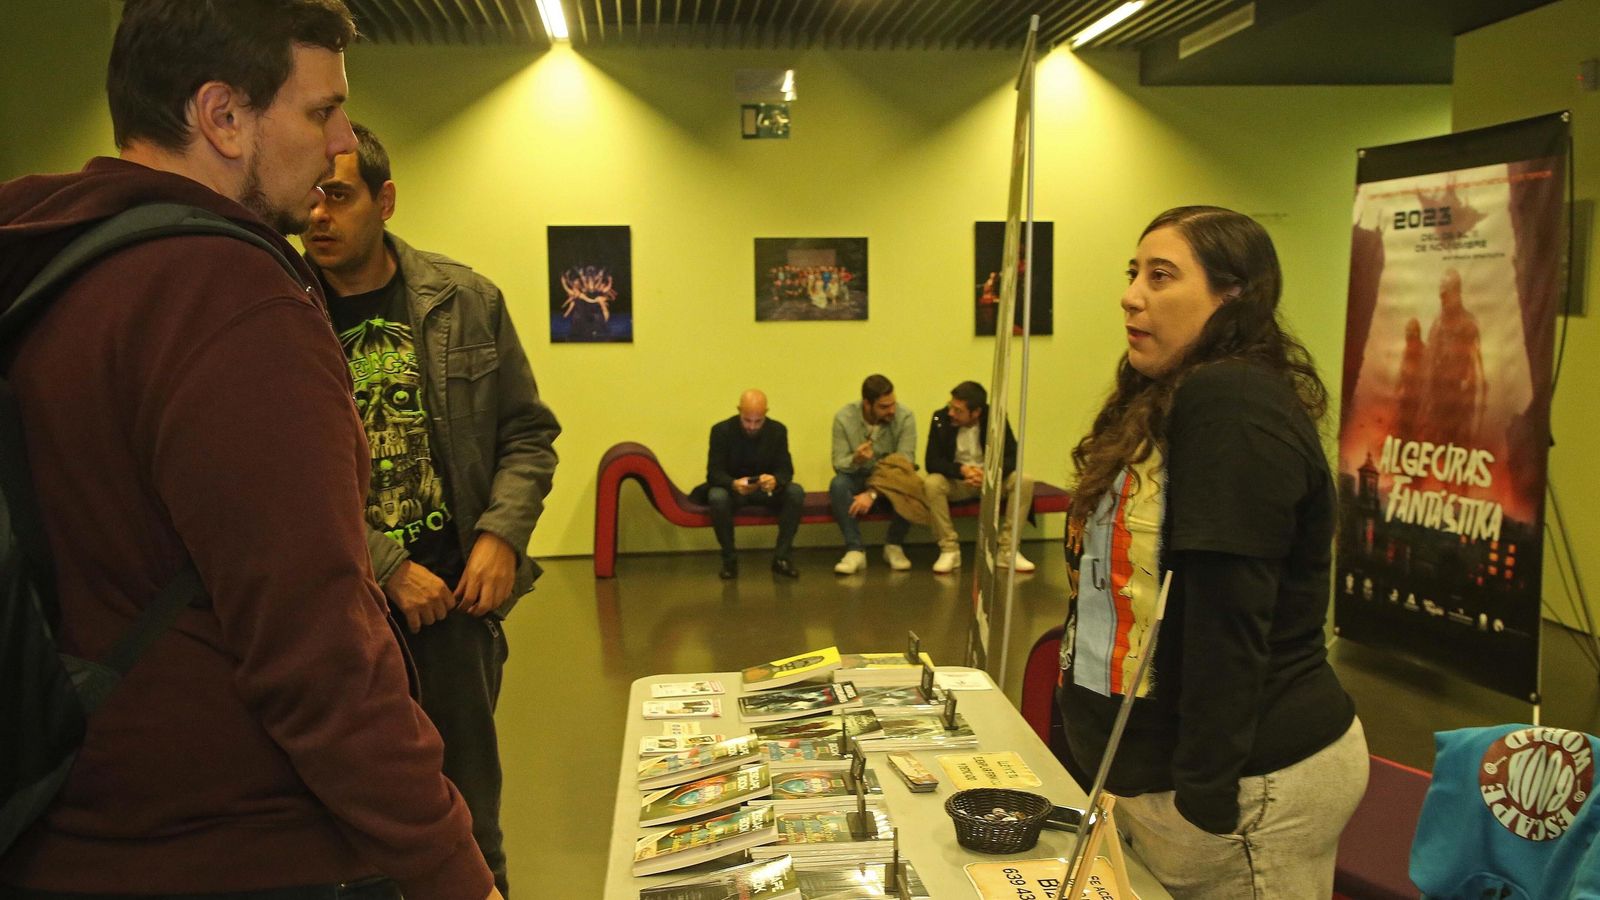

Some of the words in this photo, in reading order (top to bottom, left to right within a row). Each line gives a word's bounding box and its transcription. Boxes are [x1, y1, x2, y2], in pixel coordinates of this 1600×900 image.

[1393, 205, 1452, 230] 2023
[1379, 434, 1495, 488] ALGECIRAS
[828, 742, 842, 756] BOOK
[1503, 727, 1592, 776] WORLD
[736, 774, 749, 792] BOOK
[1507, 744, 1576, 816] ROOM
[1480, 782, 1577, 842] ESCAPE
[738, 816, 750, 834] BOOK
[1002, 867, 1026, 886] 639
